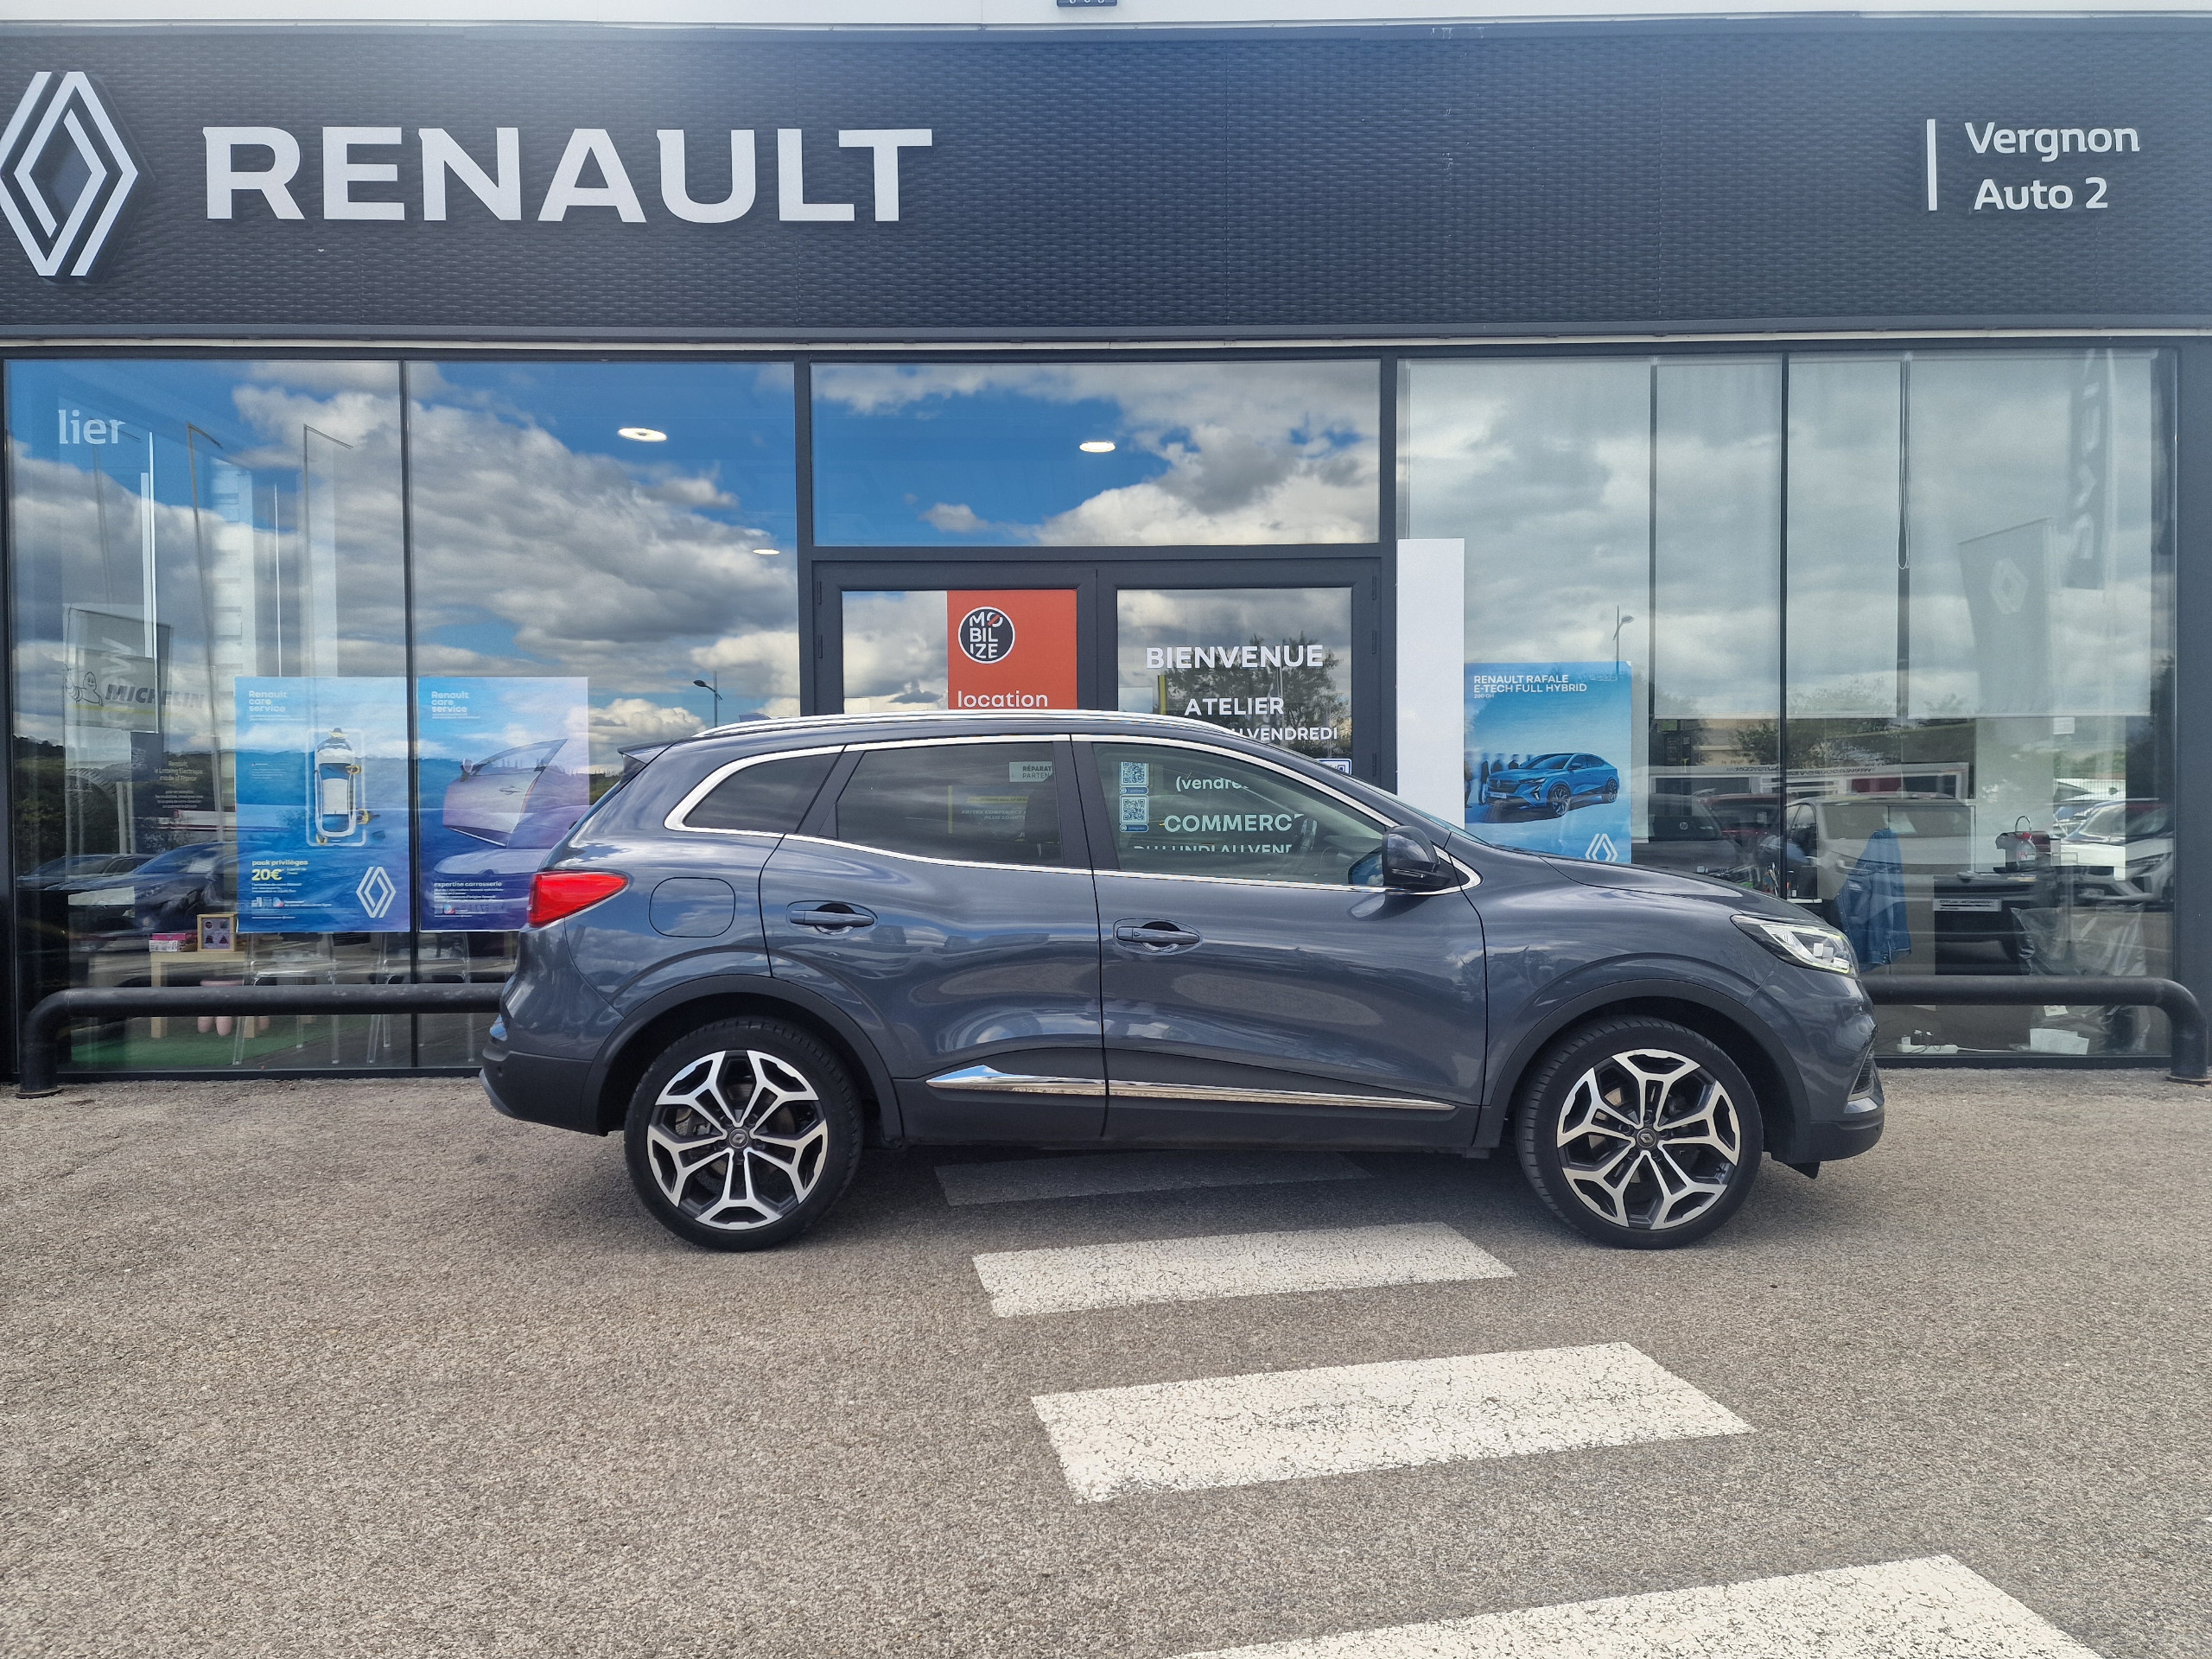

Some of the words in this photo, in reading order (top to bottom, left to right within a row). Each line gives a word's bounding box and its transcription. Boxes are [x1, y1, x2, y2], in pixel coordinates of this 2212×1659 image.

[1964, 121, 2141, 162] Vergnon
[202, 126, 933, 224] RENAULT
[1974, 178, 2074, 211] Auto
[2084, 176, 2109, 209] 2
[58, 409, 126, 445] lier
[1146, 645, 1324, 669] BIENVENUE
[1473, 675, 1524, 684] RENAULT
[1526, 674, 1569, 683] RAFALE
[1473, 684, 1512, 693] E-TECH
[1516, 683, 1543, 693] FULL
[1546, 683, 1587, 692] HYBRID
[248, 690, 288, 699] Renault
[431, 690, 469, 699] Renault
[957, 690, 1048, 708] location
[1185, 696, 1284, 716] ATELIER
[1246, 727, 1338, 741] VENDREDI
[1176, 776, 1249, 792] (vendre
[1164, 813, 1305, 833] COMMERC
[251, 868, 283, 881] 20€
